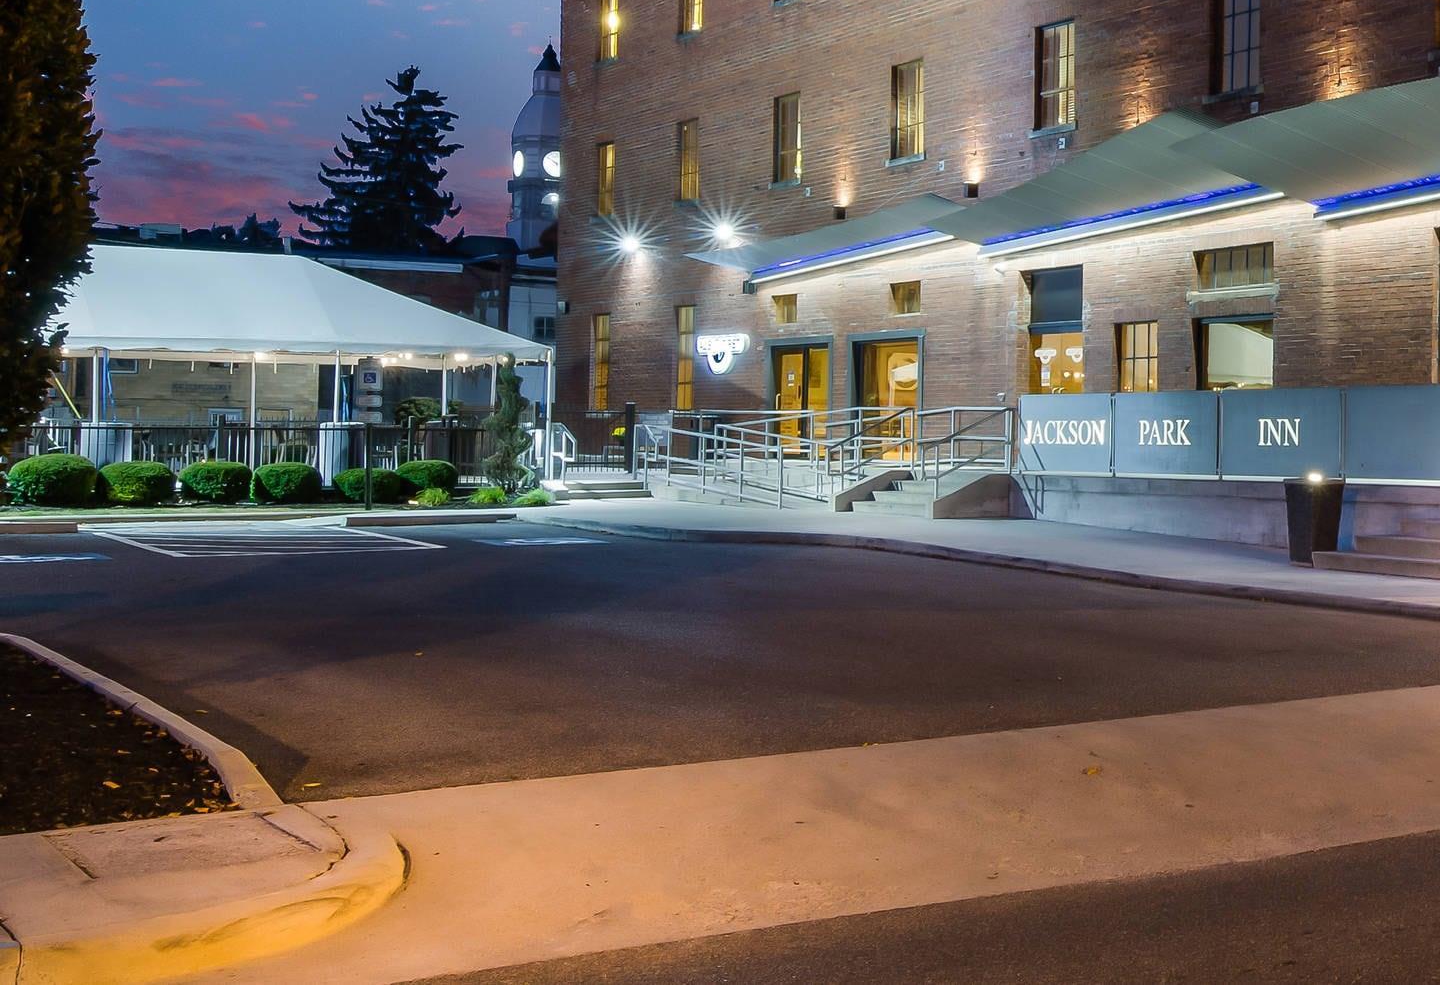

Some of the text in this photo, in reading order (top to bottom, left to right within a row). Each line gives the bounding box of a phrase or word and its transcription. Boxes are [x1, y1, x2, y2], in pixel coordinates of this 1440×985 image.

[1023, 418, 1301, 446] JACKSON PARK INN
